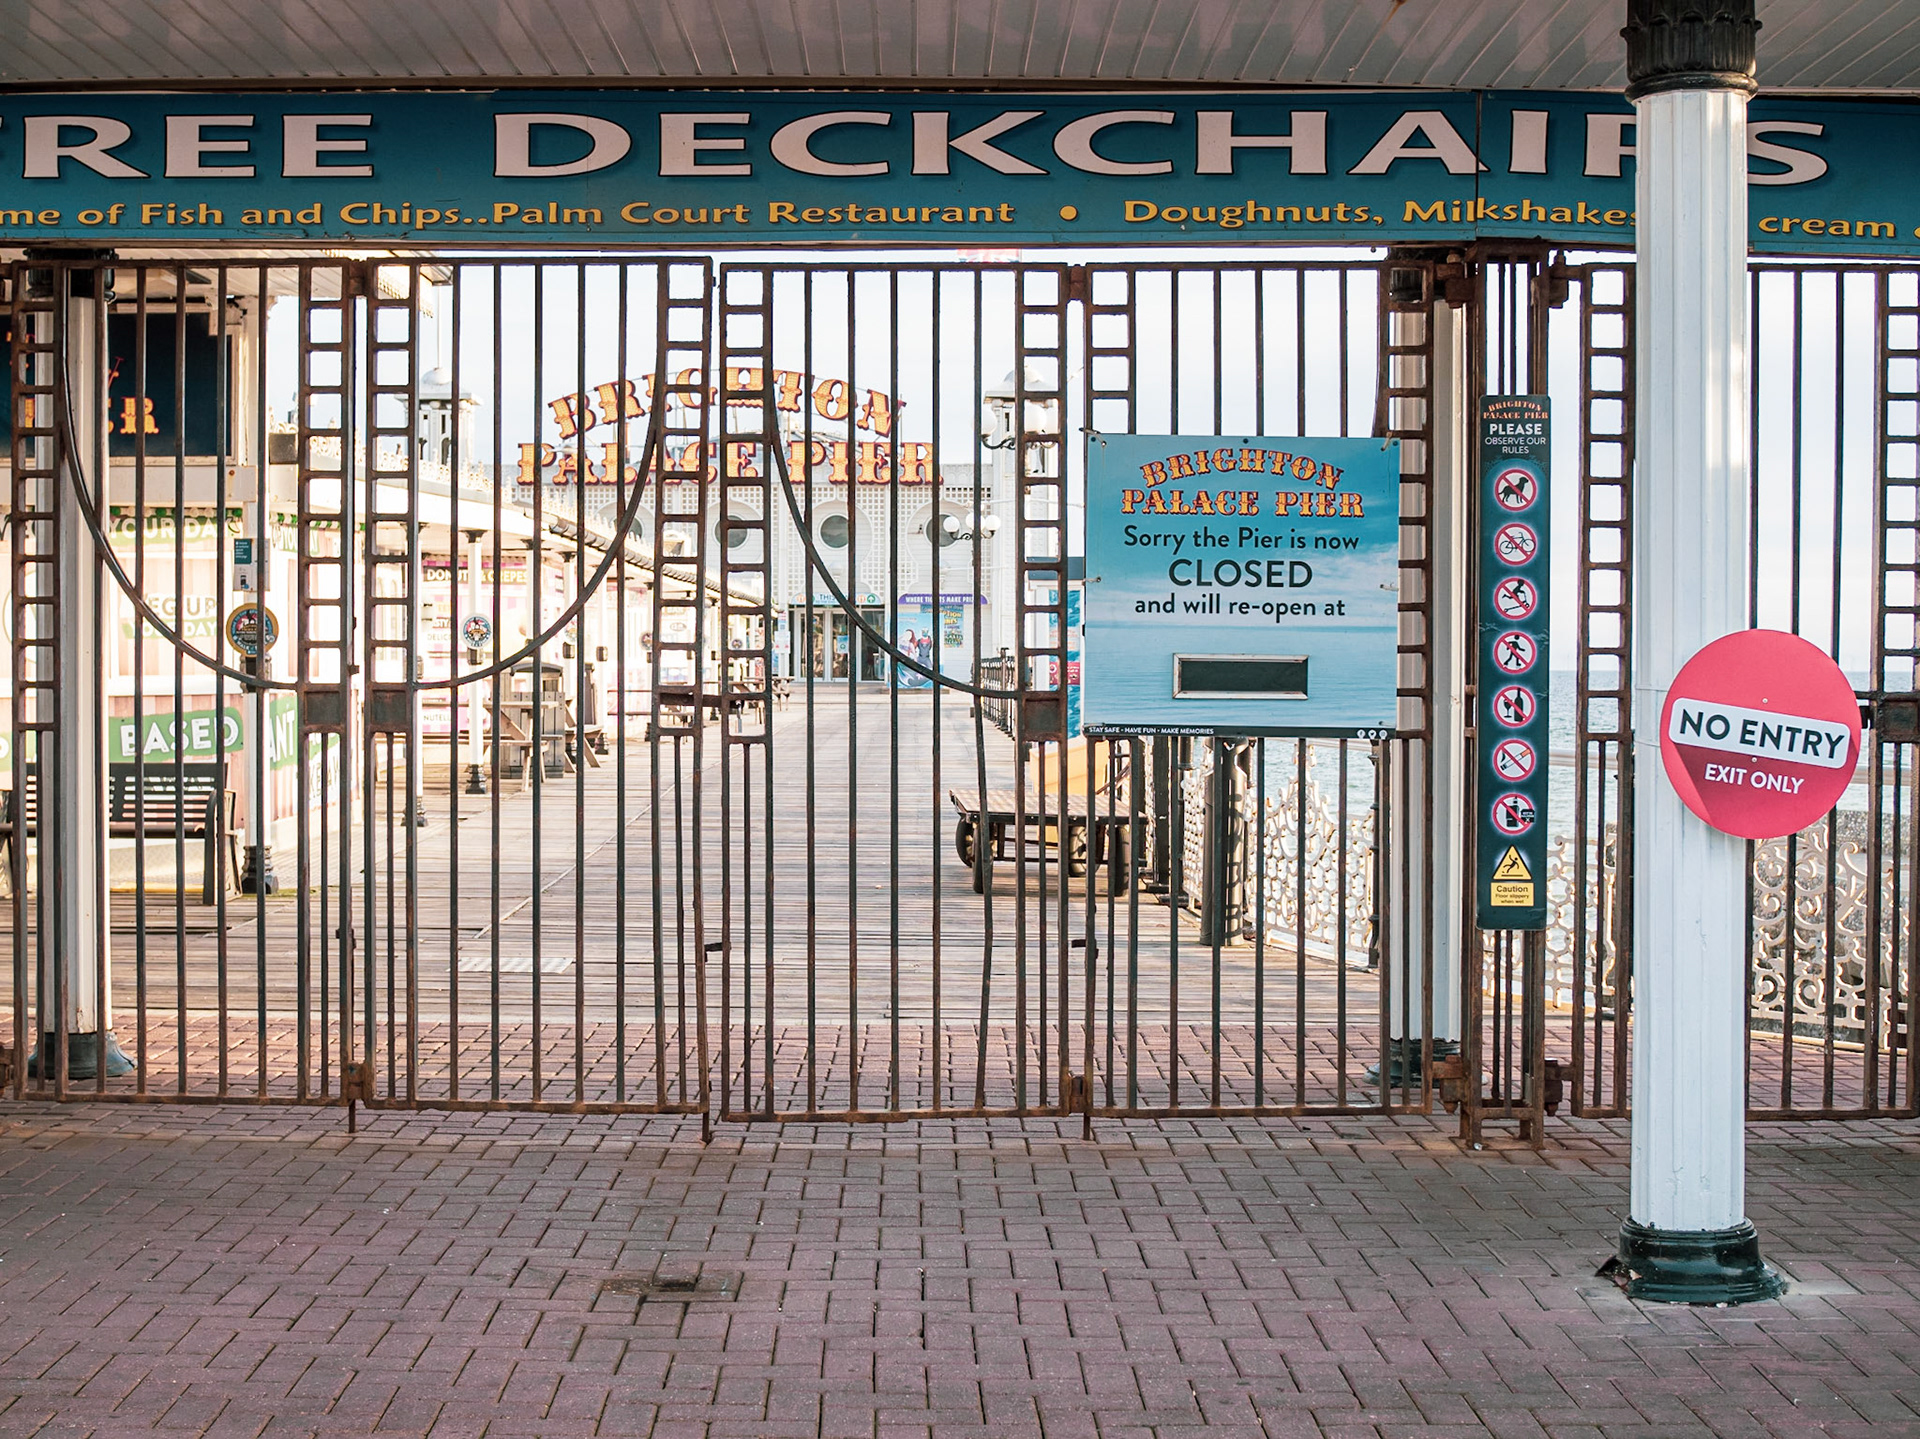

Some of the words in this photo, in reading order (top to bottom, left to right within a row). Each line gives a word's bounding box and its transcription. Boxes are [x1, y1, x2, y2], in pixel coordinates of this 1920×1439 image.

[0, 113, 374, 179] REE
[77, 203, 125, 225] of
[140, 203, 223, 225] Fish
[240, 202, 322, 225] and
[620, 202, 750, 224] Court
[768, 202, 1015, 225] Restaurant
[1124, 200, 1385, 229] Doughnuts,
[1758, 214, 1896, 238] cream
[1488, 401, 1542, 411] BRIGHTON
[1484, 436, 1525, 445] OBSERVE
[1526, 436, 1547, 445] OUR
[1489, 423, 1543, 436] PLEASE
[785, 441, 944, 486] PIER
[1502, 445, 1530, 454] RULES
[1139, 447, 1344, 490] BRIGHTON
[1120, 488, 1260, 517] PALACE
[1274, 491, 1365, 518] PIER
[1123, 525, 1186, 555] Sorry
[1192, 526, 1230, 548] the
[1238, 527, 1283, 549] Pier
[1290, 528, 1307, 550] is
[1314, 533, 1359, 550] now
[427, 569, 468, 582] DONUT
[488, 570, 527, 583] CEPES
[1168, 559, 1313, 588] CLOSED
[1134, 592, 1176, 614] and
[1183, 593, 1221, 614] will
[1228, 599, 1317, 624] re-open
[1324, 600, 1346, 616] at
[120, 715, 239, 757] BASED
[1104, 726, 1120, 734] SAFE
[1160, 727, 1179, 735] MAKE
[1179, 727, 1215, 735] MEMORIES
[1679, 708, 1731, 740] NO
[1738, 718, 1845, 760] ENTRY
[1703, 763, 1748, 786] EXIT
[1749, 771, 1805, 795] ONLY
[1496, 885, 1529, 893] Caution
